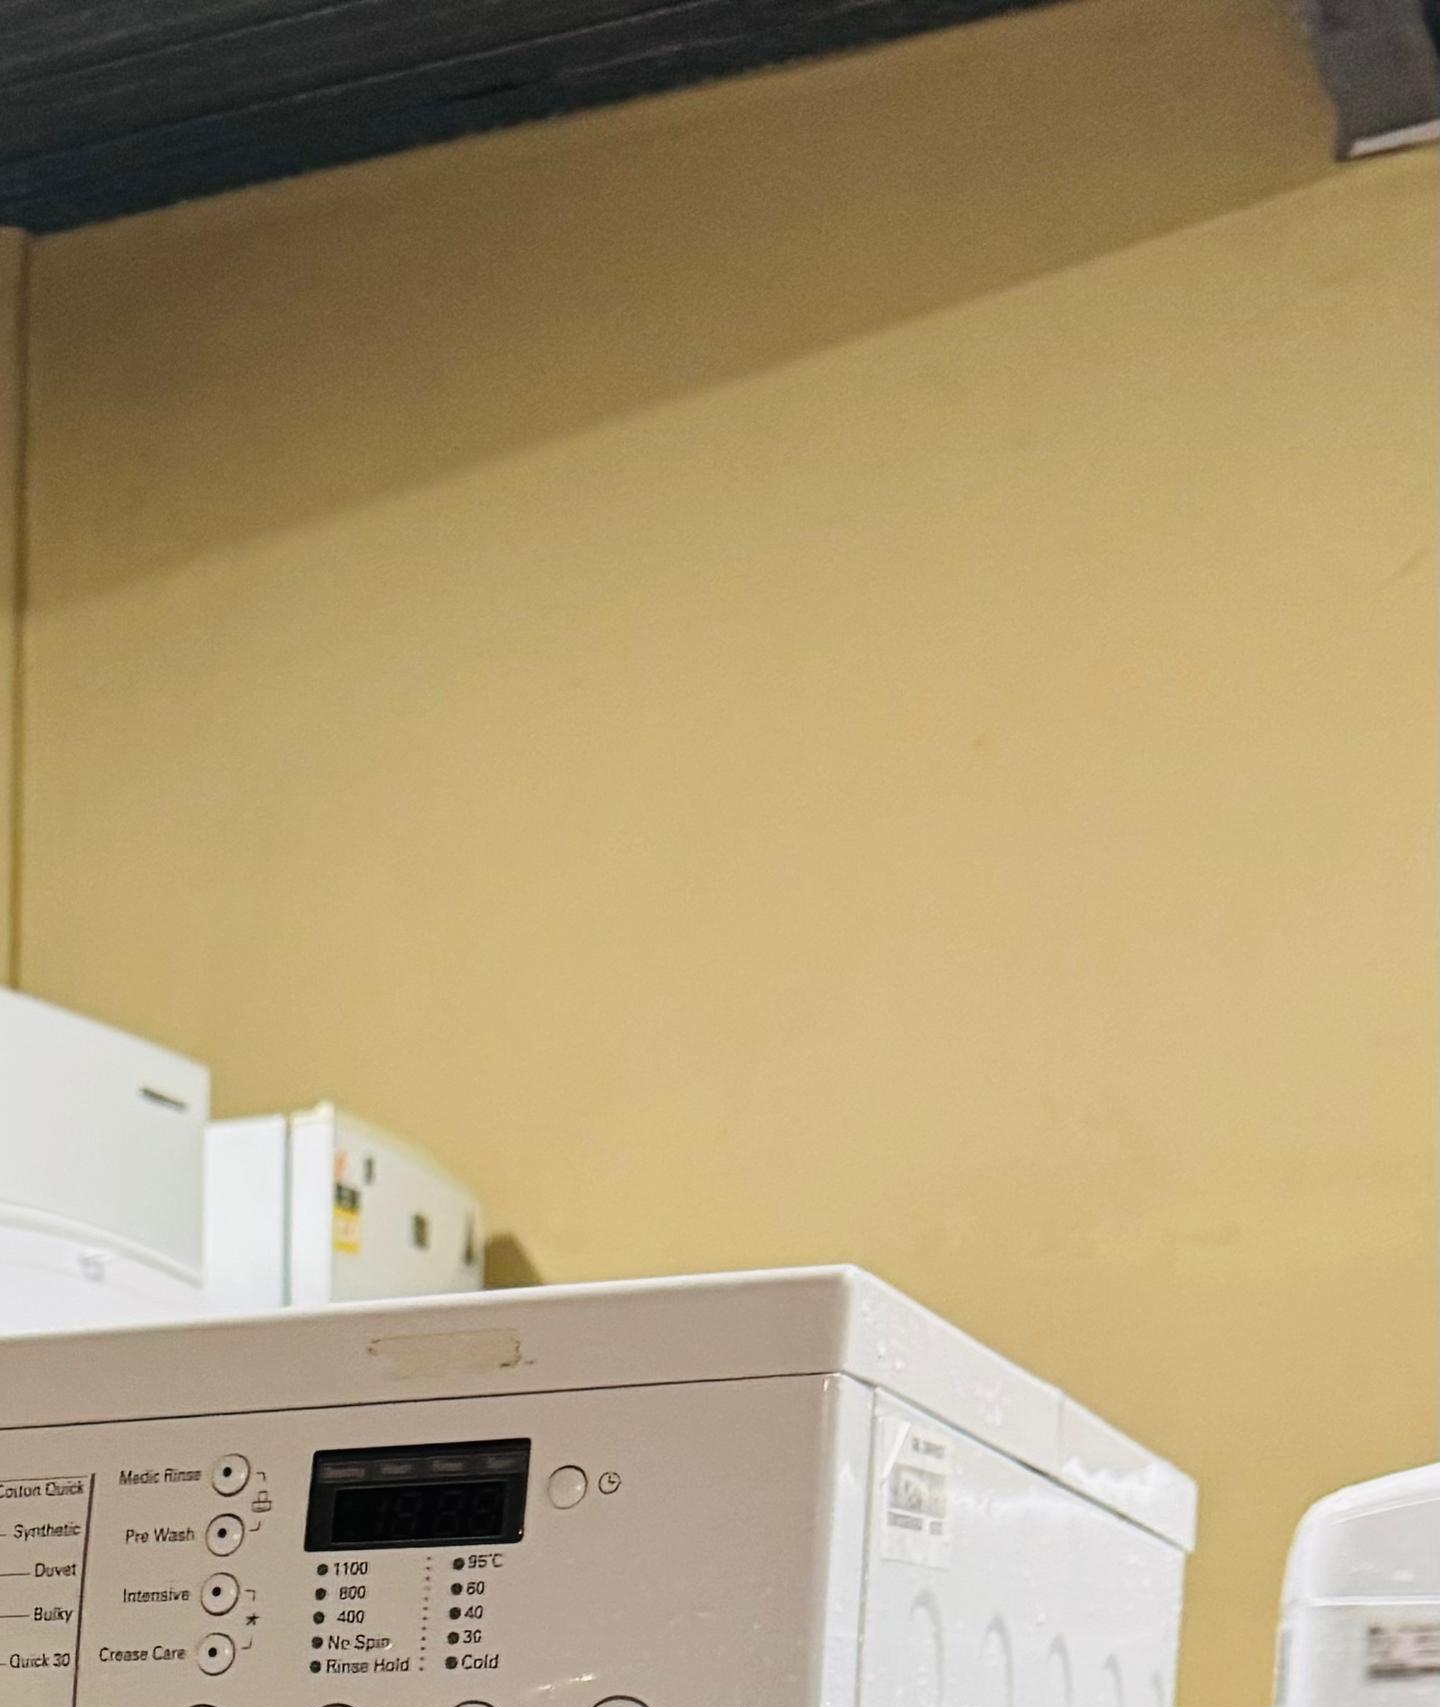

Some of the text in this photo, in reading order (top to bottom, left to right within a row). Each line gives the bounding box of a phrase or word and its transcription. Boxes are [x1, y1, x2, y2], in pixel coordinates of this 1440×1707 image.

[119, 1468, 202, 1485] Medic Rinse
[45, 1482, 84, 1497] Quick
[13, 1523, 81, 1541] Synthetic
[126, 1527, 195, 1543] Pre Wash
[35, 1563, 77, 1577] Duvet
[334, 1561, 368, 1576] 1100
[123, 1587, 190, 1603] Intensive
[339, 1586, 366, 1600] 800
[466, 1581, 485, 1595] 60
[34, 1607, 73, 1623] Bulky
[337, 1610, 365, 1624] 400
[464, 1605, 483, 1619] 40
[354, 1634, 391, 1651] Spin
[463, 1630, 482, 1644] 30
[10, 1652, 70, 1668] Quick 30
[99, 1646, 186, 1662] Crease Care
[462, 1654, 499, 1670] Cold
[326, 1657, 410, 1674] Rinse Hold
